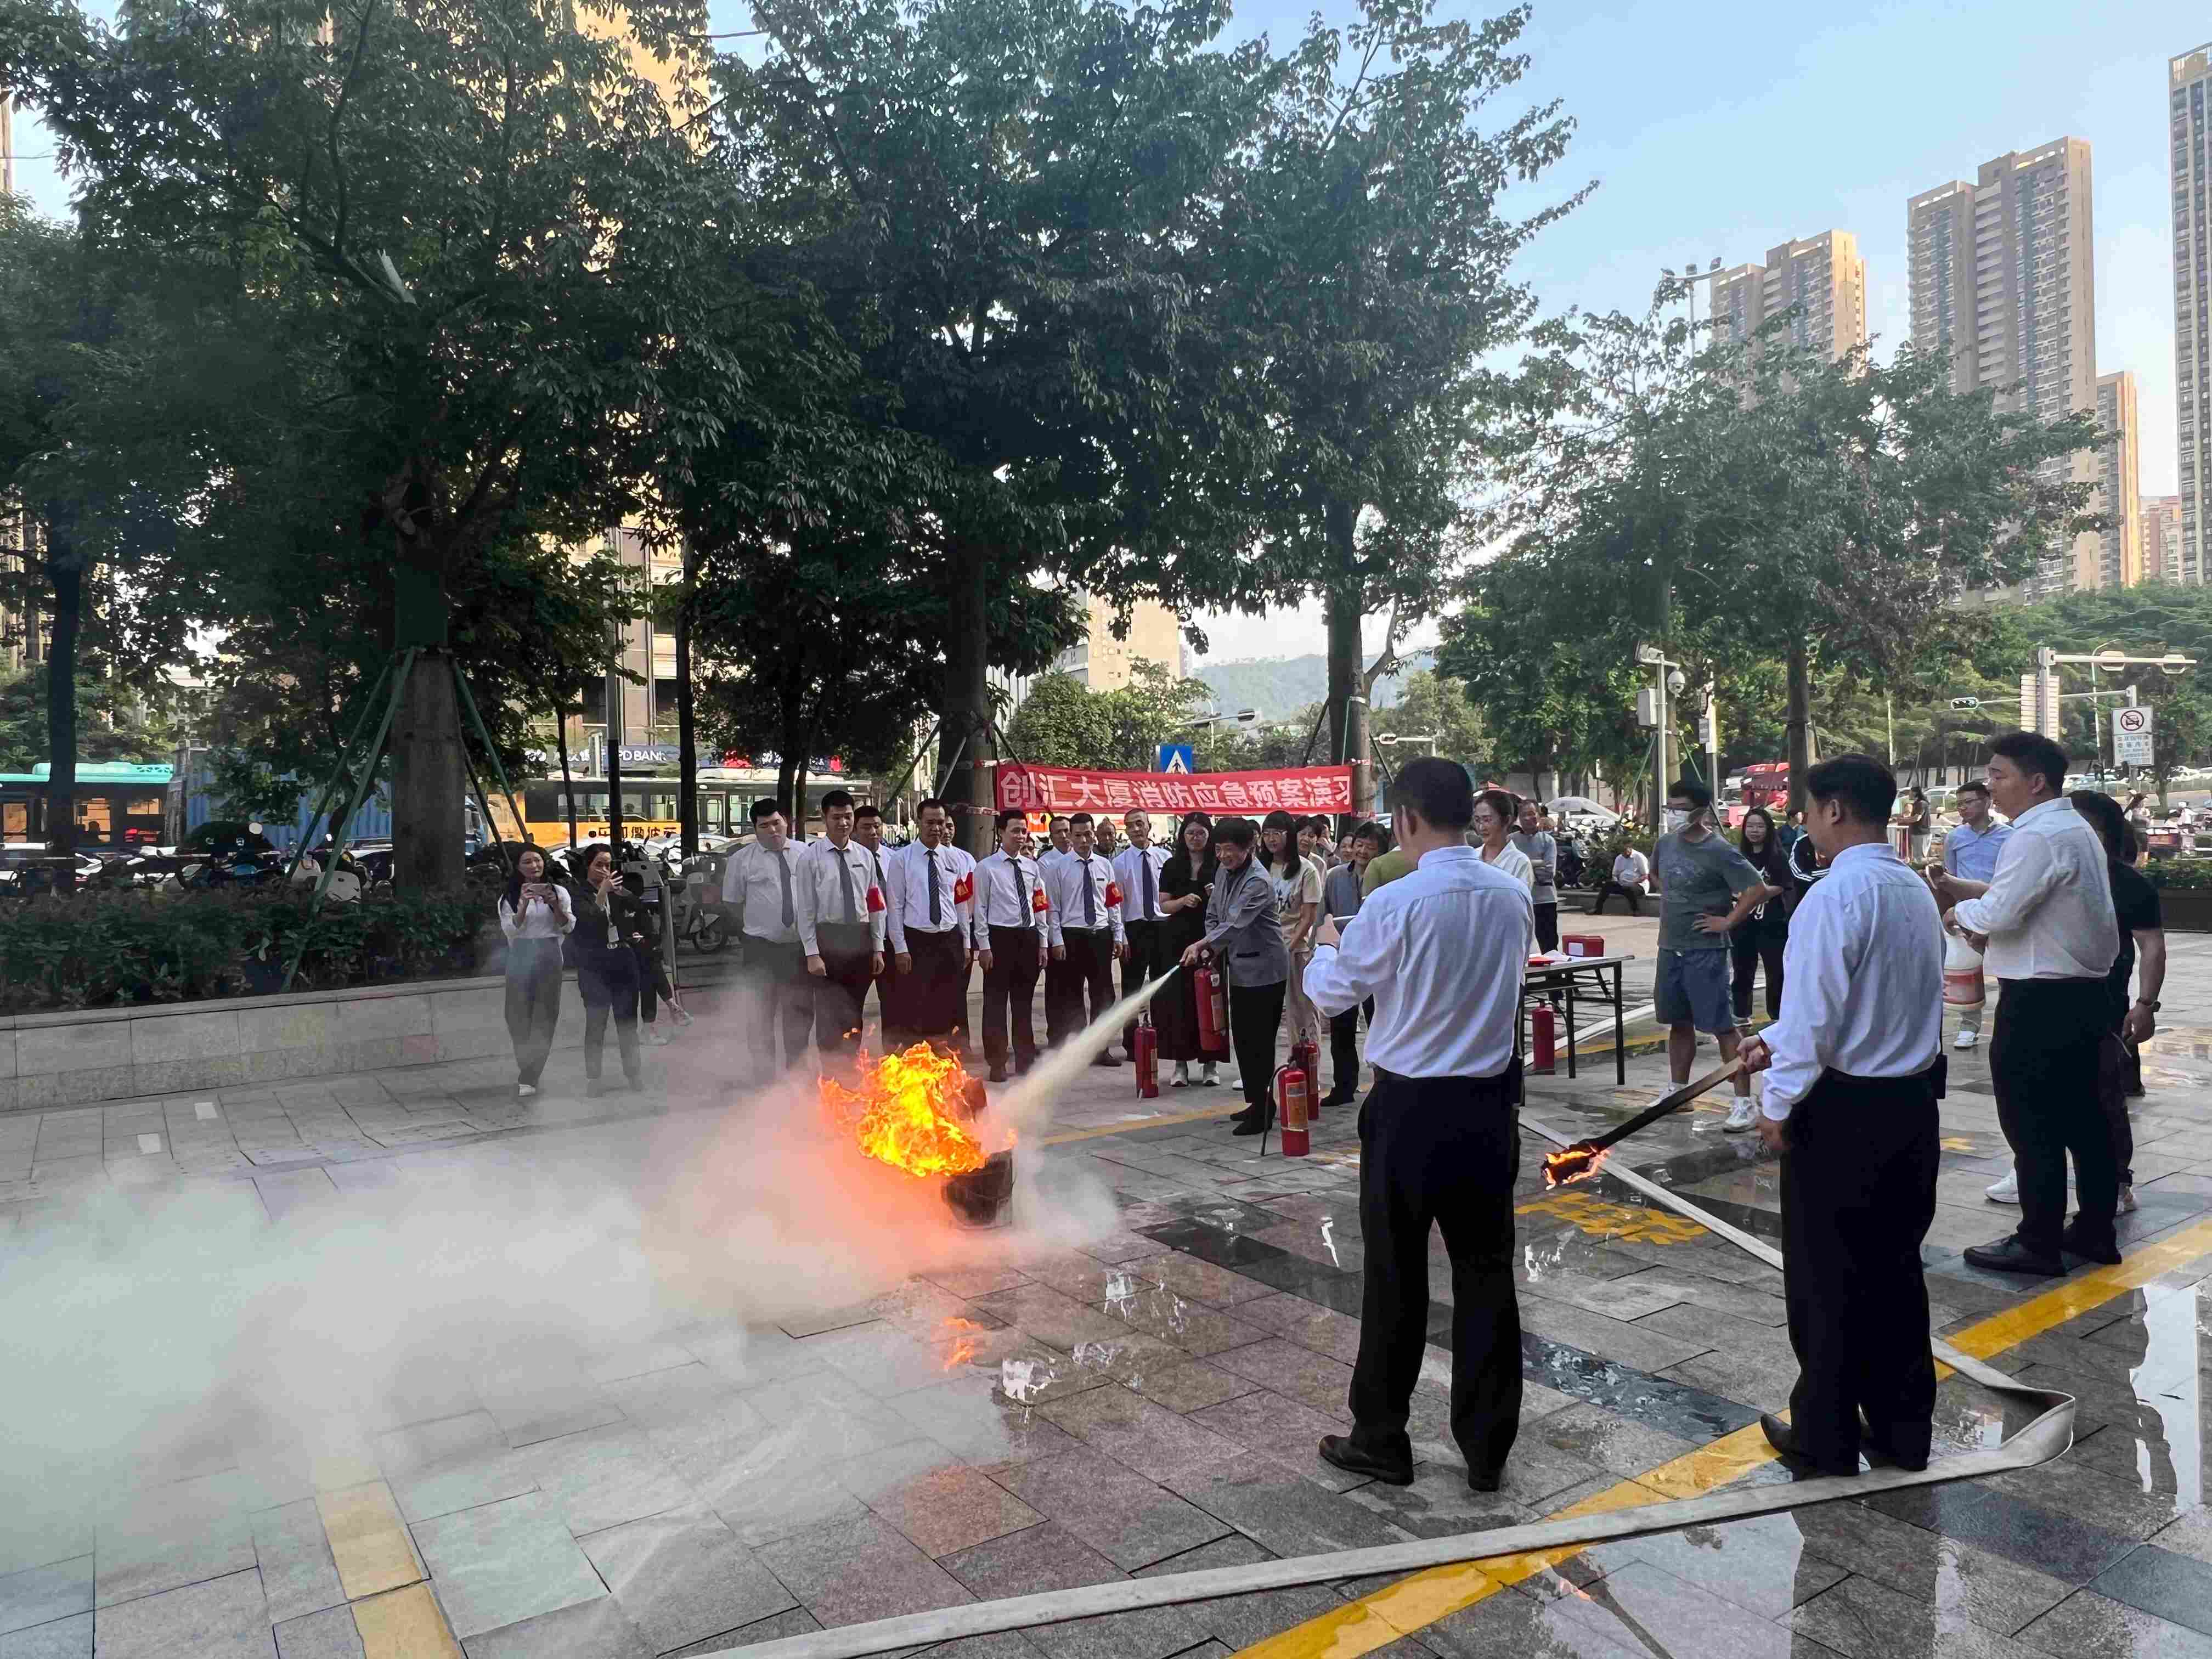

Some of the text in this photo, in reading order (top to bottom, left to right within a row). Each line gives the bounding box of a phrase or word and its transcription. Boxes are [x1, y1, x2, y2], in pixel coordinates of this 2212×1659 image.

[634, 750, 667, 761] BANK
[1000, 771, 1350, 808] 创汇大厦消防应急预案演习
